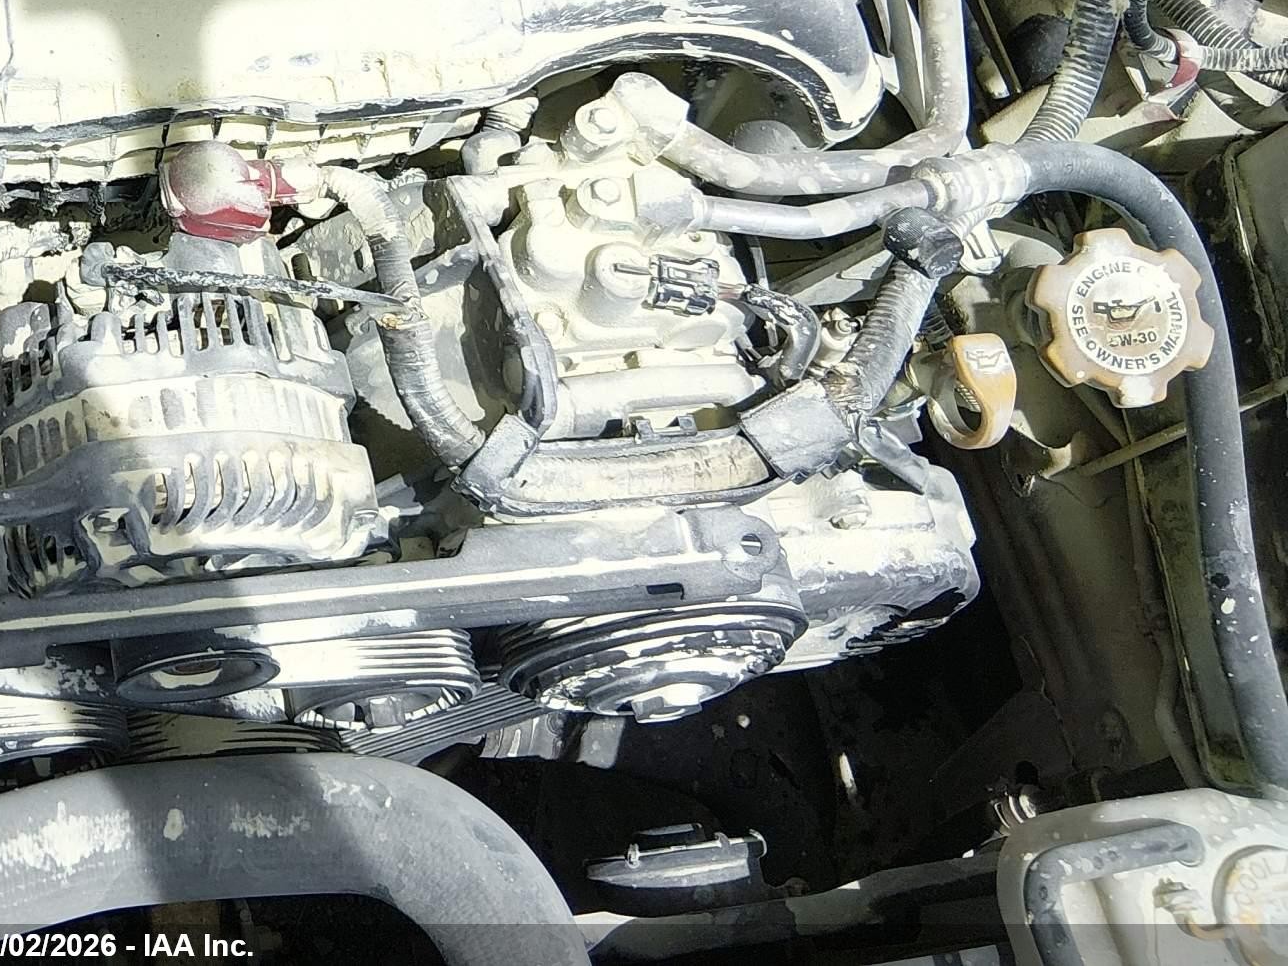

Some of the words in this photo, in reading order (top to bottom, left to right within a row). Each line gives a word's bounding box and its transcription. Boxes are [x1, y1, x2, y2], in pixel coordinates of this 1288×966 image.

[1077, 261, 1132, 298] ENGINE
[1071, 304, 1090, 338] SEE
[1085, 339, 1162, 370] OWNER'S
[1159, 290, 1184, 356] MANUAL
[1233, 856, 1288, 906] COOL
